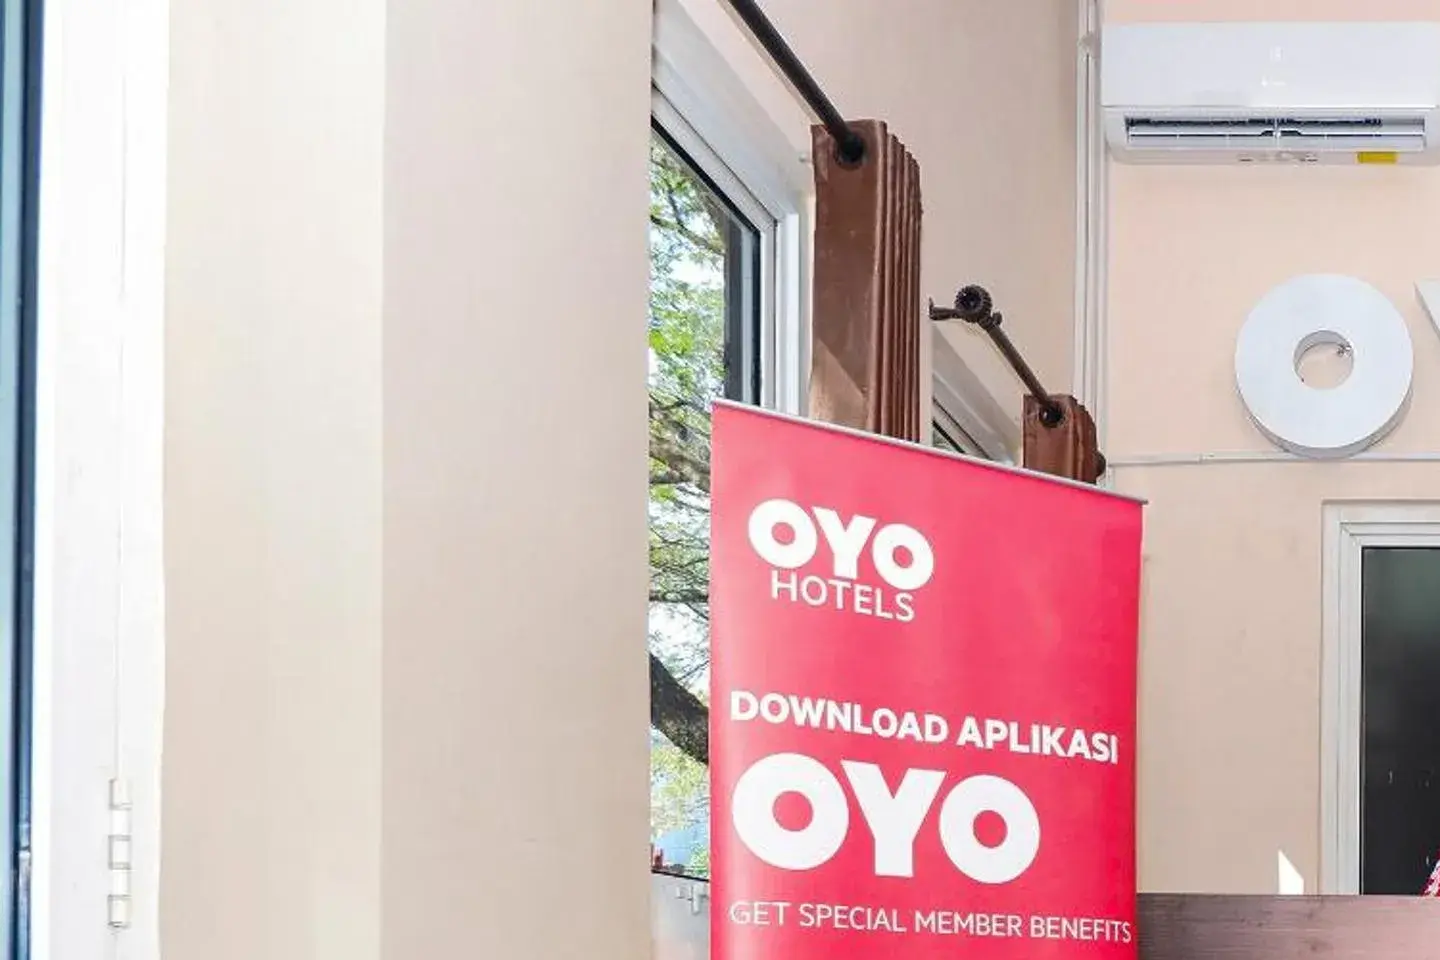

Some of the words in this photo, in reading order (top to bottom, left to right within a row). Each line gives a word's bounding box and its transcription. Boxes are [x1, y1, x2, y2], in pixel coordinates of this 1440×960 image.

[748, 499, 934, 590] OYO
[770, 570, 915, 622] HOTELS
[730, 690, 948, 742] DOWNLOAD
[957, 717, 1118, 764] APLIKASI
[732, 753, 1040, 884] OYO
[729, 902, 791, 926] GET
[799, 904, 907, 933] SPECIAL
[915, 911, 1022, 938] MEMBER
[1030, 917, 1132, 943] BENEFITS
